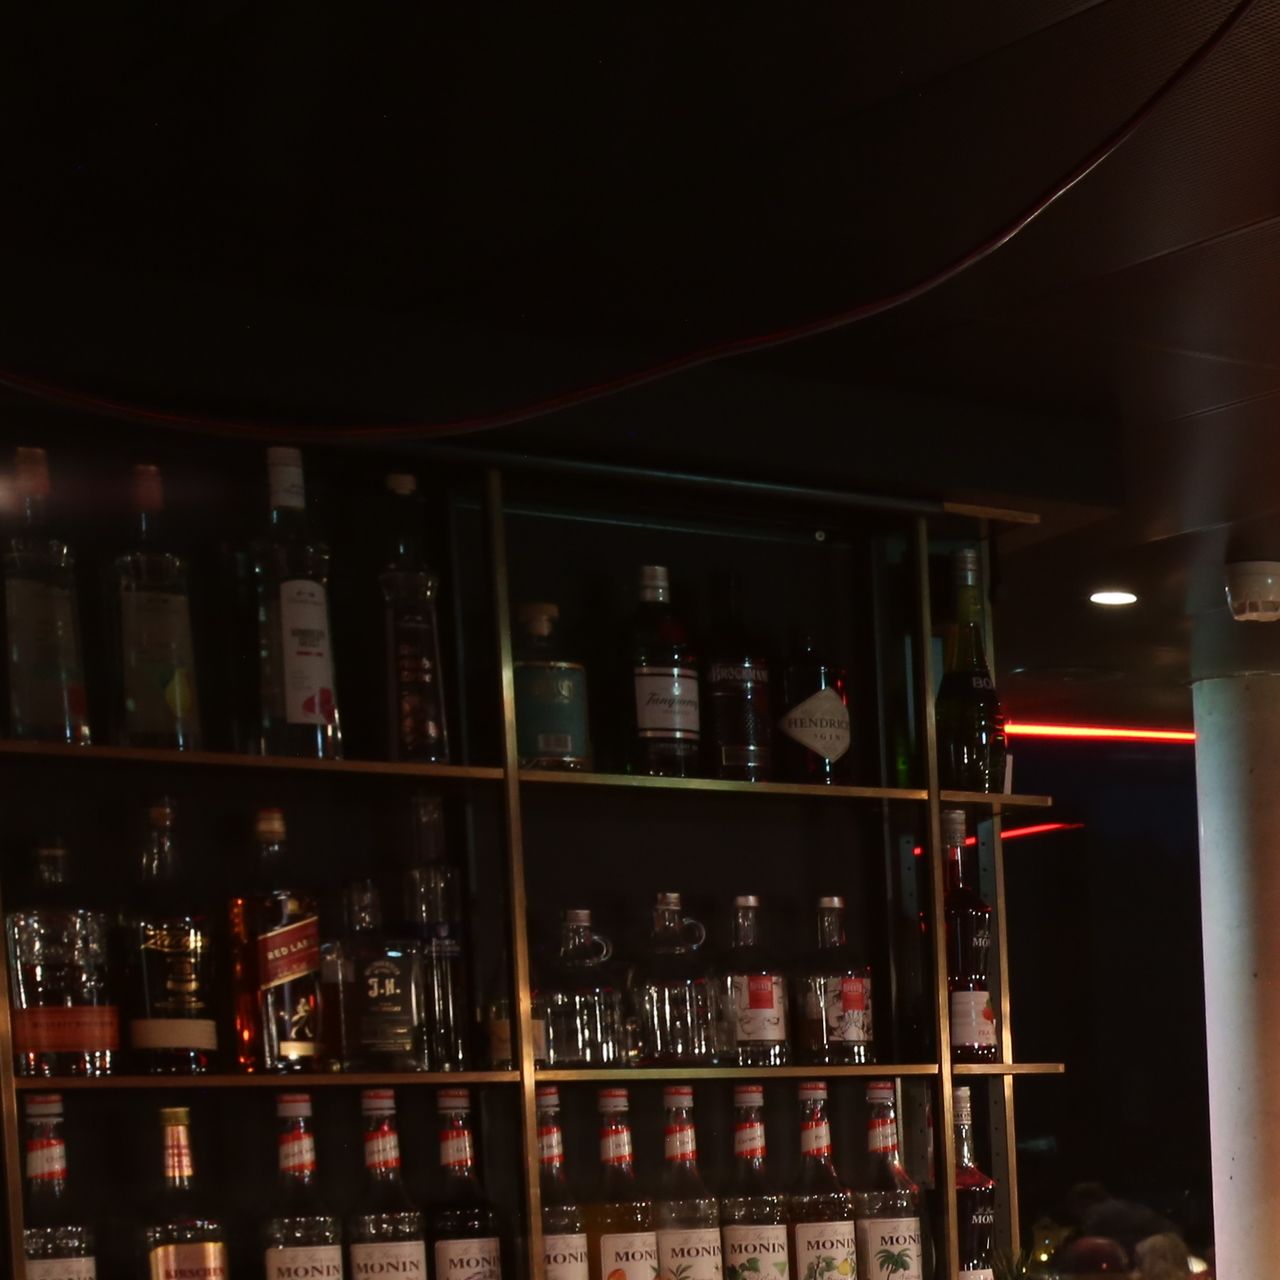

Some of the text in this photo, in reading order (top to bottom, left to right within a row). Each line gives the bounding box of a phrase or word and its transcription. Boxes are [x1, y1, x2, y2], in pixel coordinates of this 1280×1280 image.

[730, 1242, 786, 1255] MONIN
[277, 1264, 341, 1280] MONIN
[356, 1259, 420, 1274] MONIN
